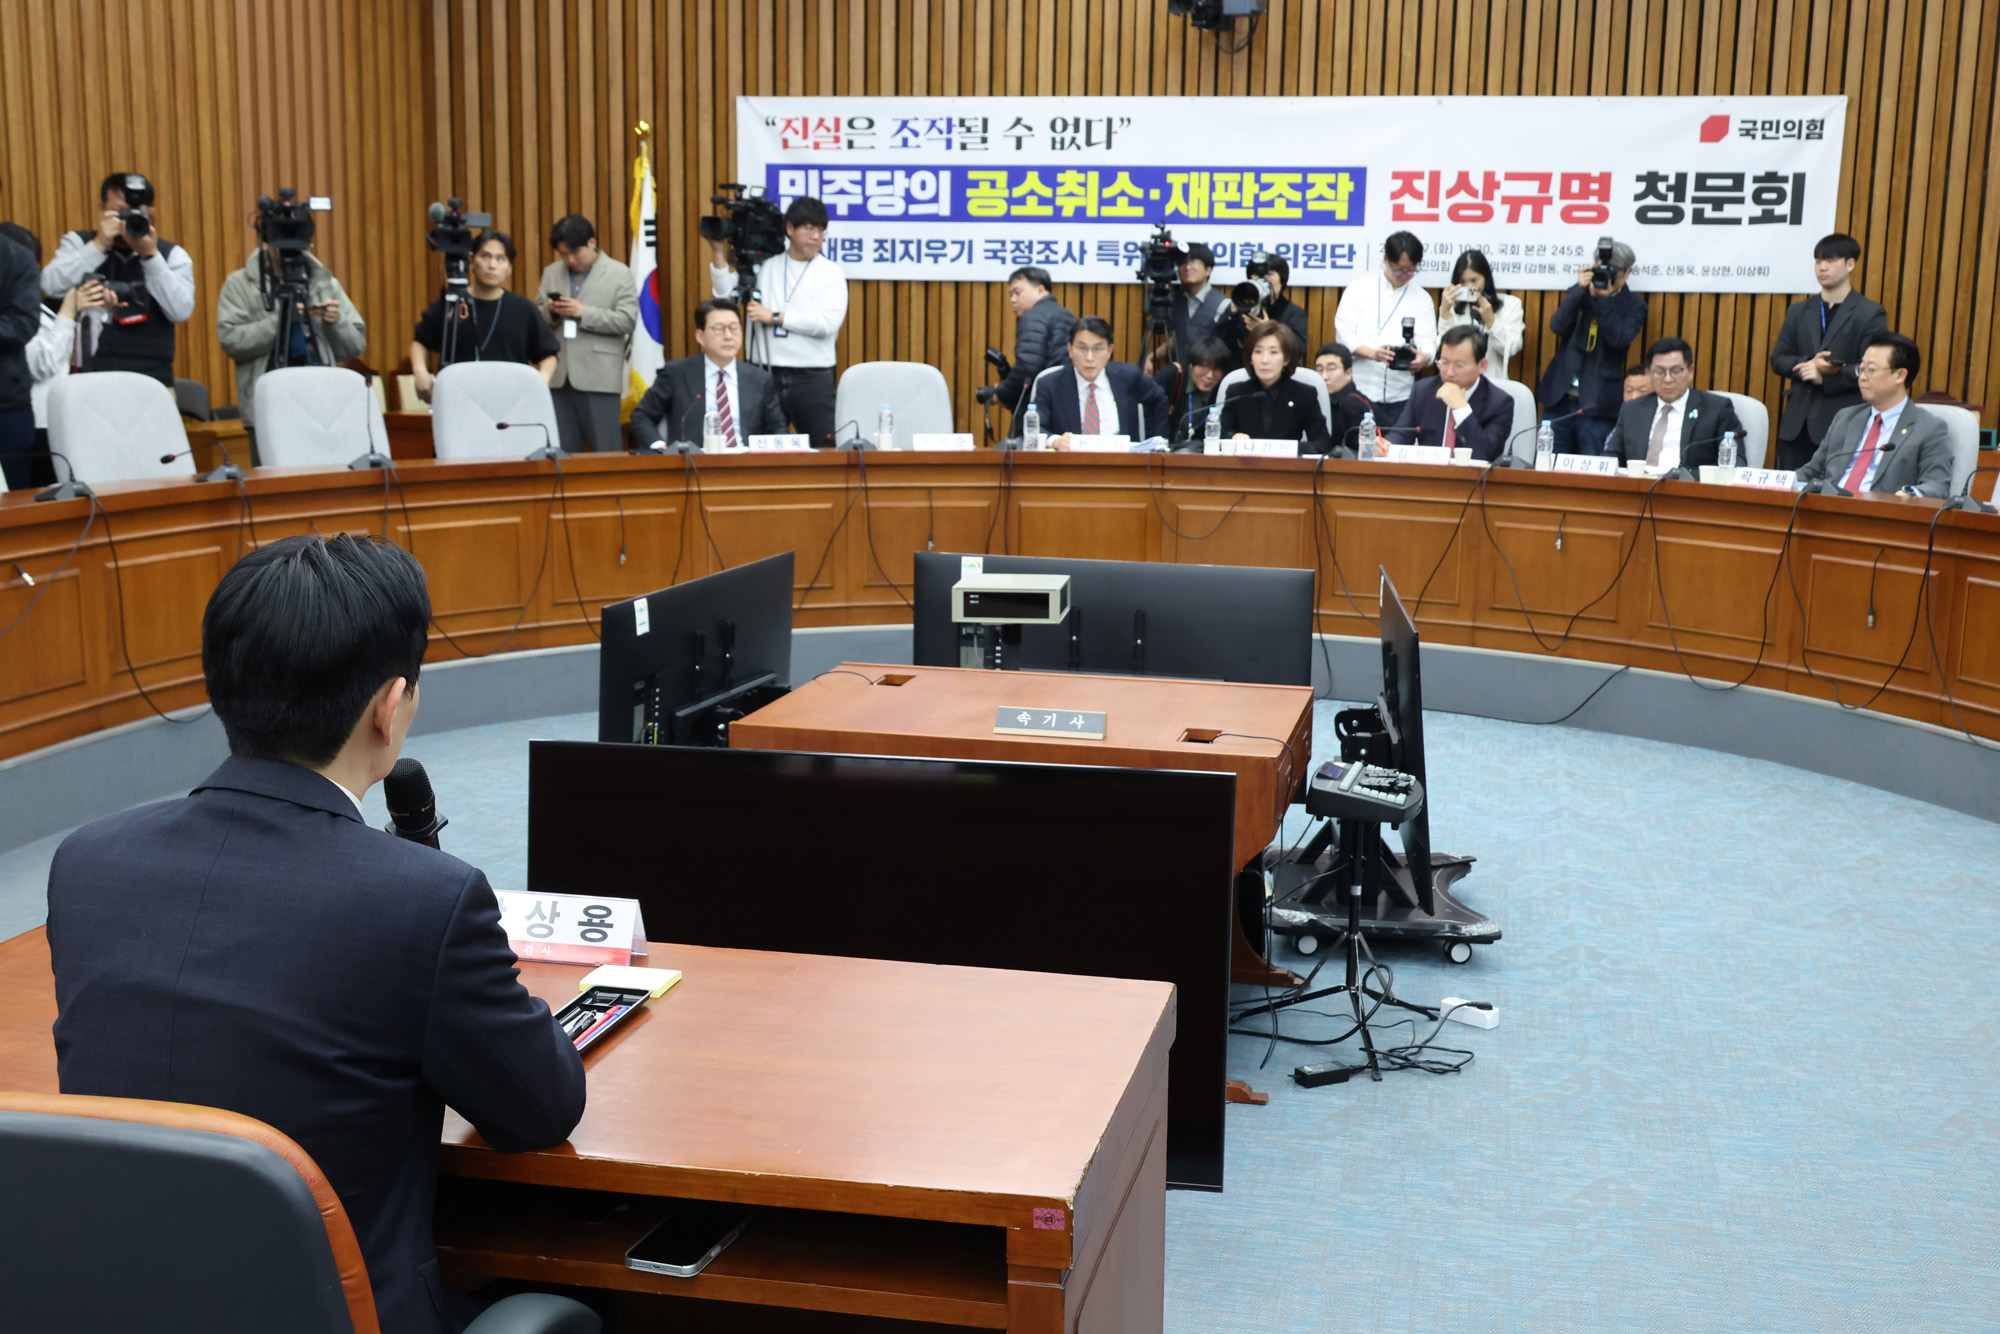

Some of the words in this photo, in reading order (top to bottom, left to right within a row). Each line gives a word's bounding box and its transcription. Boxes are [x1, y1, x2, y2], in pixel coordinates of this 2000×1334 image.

[889, 116, 990, 151] 조작될
[1002, 116, 1036, 151] 수
[1737, 118, 1825, 141] 국민의힘
[778, 169, 952, 217] 민주당의
[966, 170, 1355, 221] 공소취소·재판조작
[1390, 170, 1613, 225] 진상규명
[1633, 171, 1807, 227] 청문회
[818, 237, 864, 262] 재명
[873, 238, 974, 264] 죄지우기
[983, 239, 1087, 266] 국정조사
[1275, 242, 1357, 270] 위원단
[1498, 243, 1520, 256] 국회
[1525, 244, 1547, 257] 본관
[1551, 245, 1585, 257] 245호
[499, 897, 614, 943] 상용
